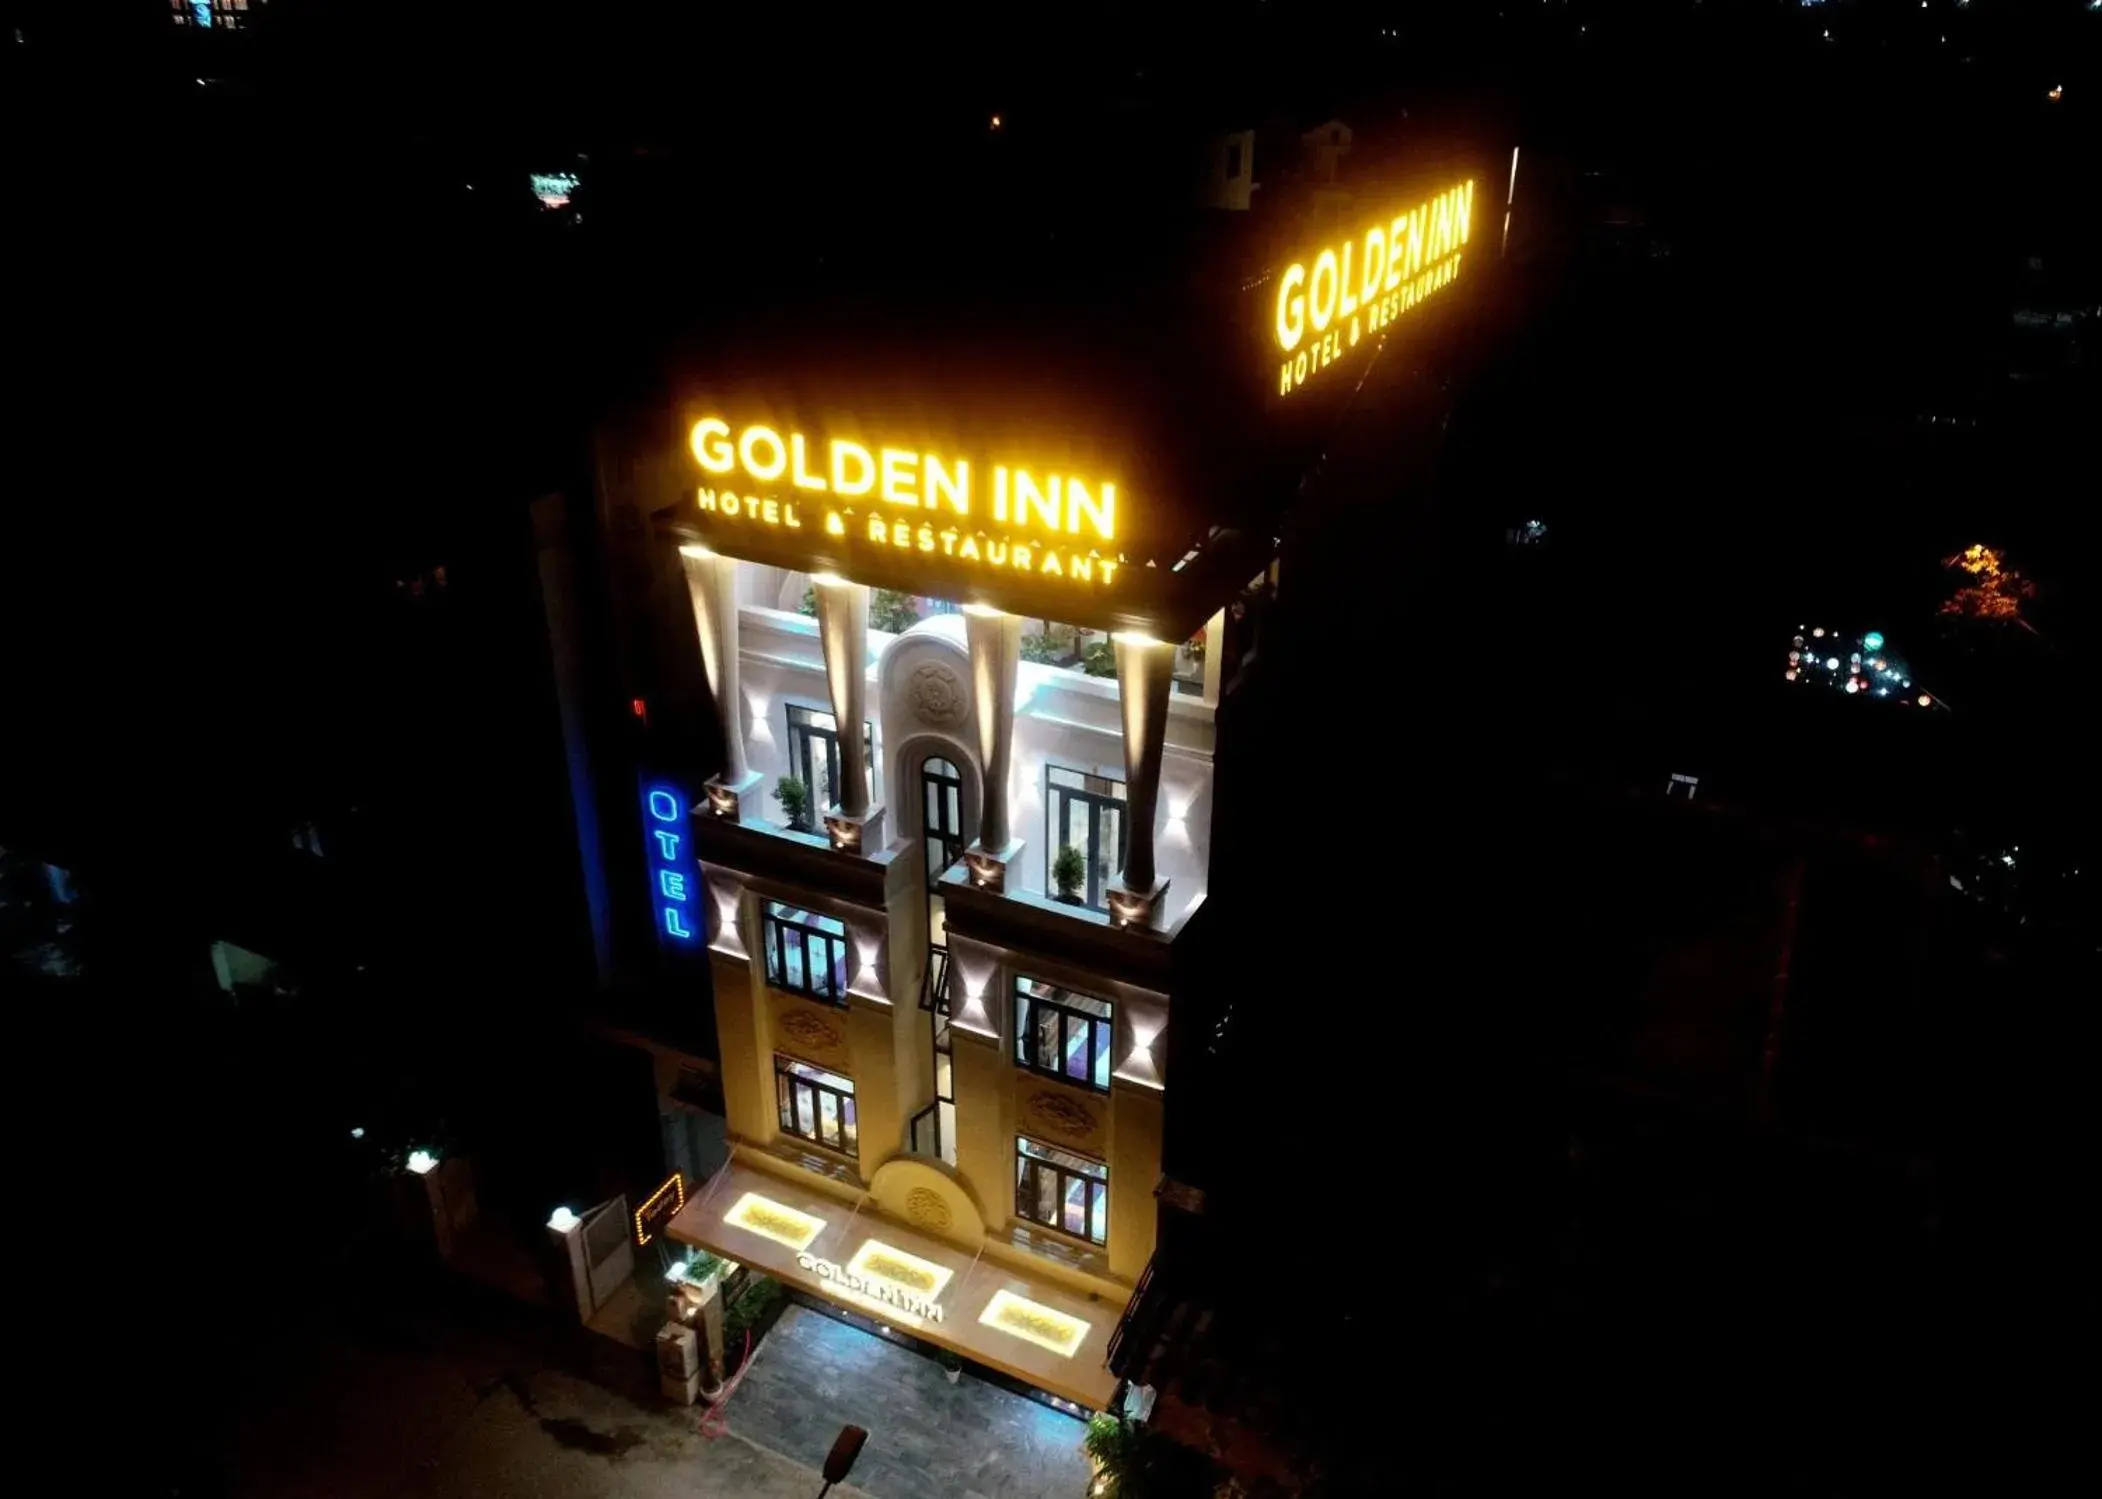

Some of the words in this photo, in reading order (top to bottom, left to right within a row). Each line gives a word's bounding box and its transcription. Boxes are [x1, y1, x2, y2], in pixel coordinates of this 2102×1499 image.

[1276, 203, 1428, 352] GOLDEN
[1424, 178, 1474, 266] INN
[1279, 329, 1342, 396] HOTEL
[1368, 252, 1461, 334] RESTAURANT
[689, 418, 970, 516] GOLDEN
[992, 465, 1117, 540] INN
[697, 487, 801, 528] HOTEL
[825, 510, 845, 535] &
[867, 519, 1118, 584] RESTAURANT
[649, 790, 690, 938] OTEL
